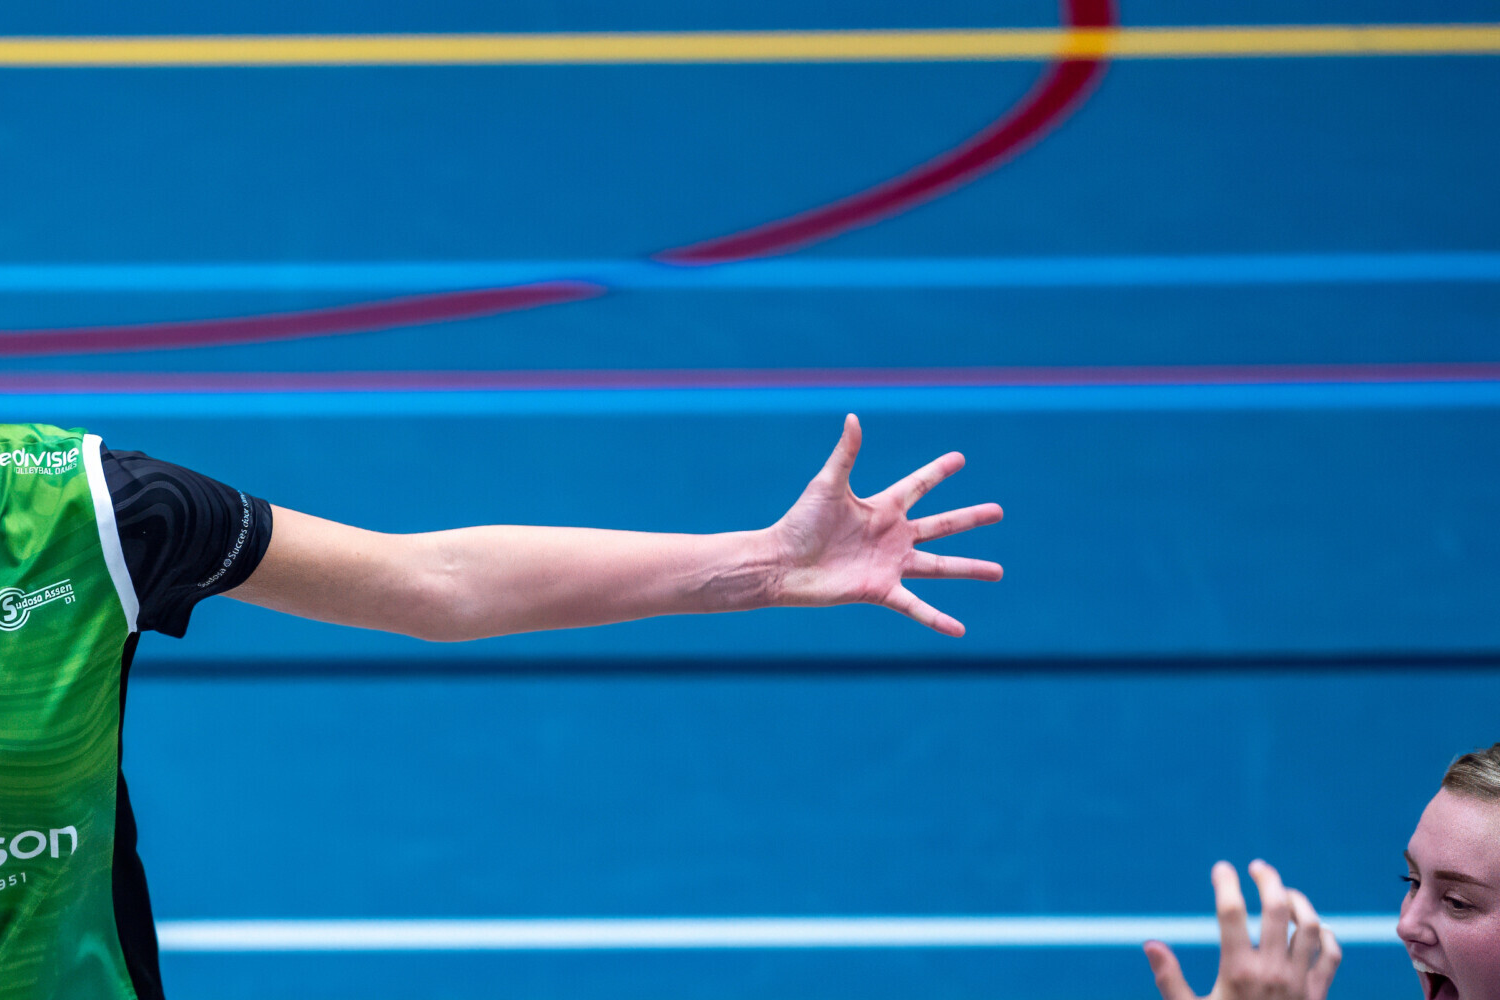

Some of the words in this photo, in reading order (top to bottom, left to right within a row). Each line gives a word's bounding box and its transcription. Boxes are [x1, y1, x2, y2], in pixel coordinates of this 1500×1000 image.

[228, 528, 248, 560] Succes
[1, 593, 43, 622] Sudosa
[44, 583, 73, 601] Assen
